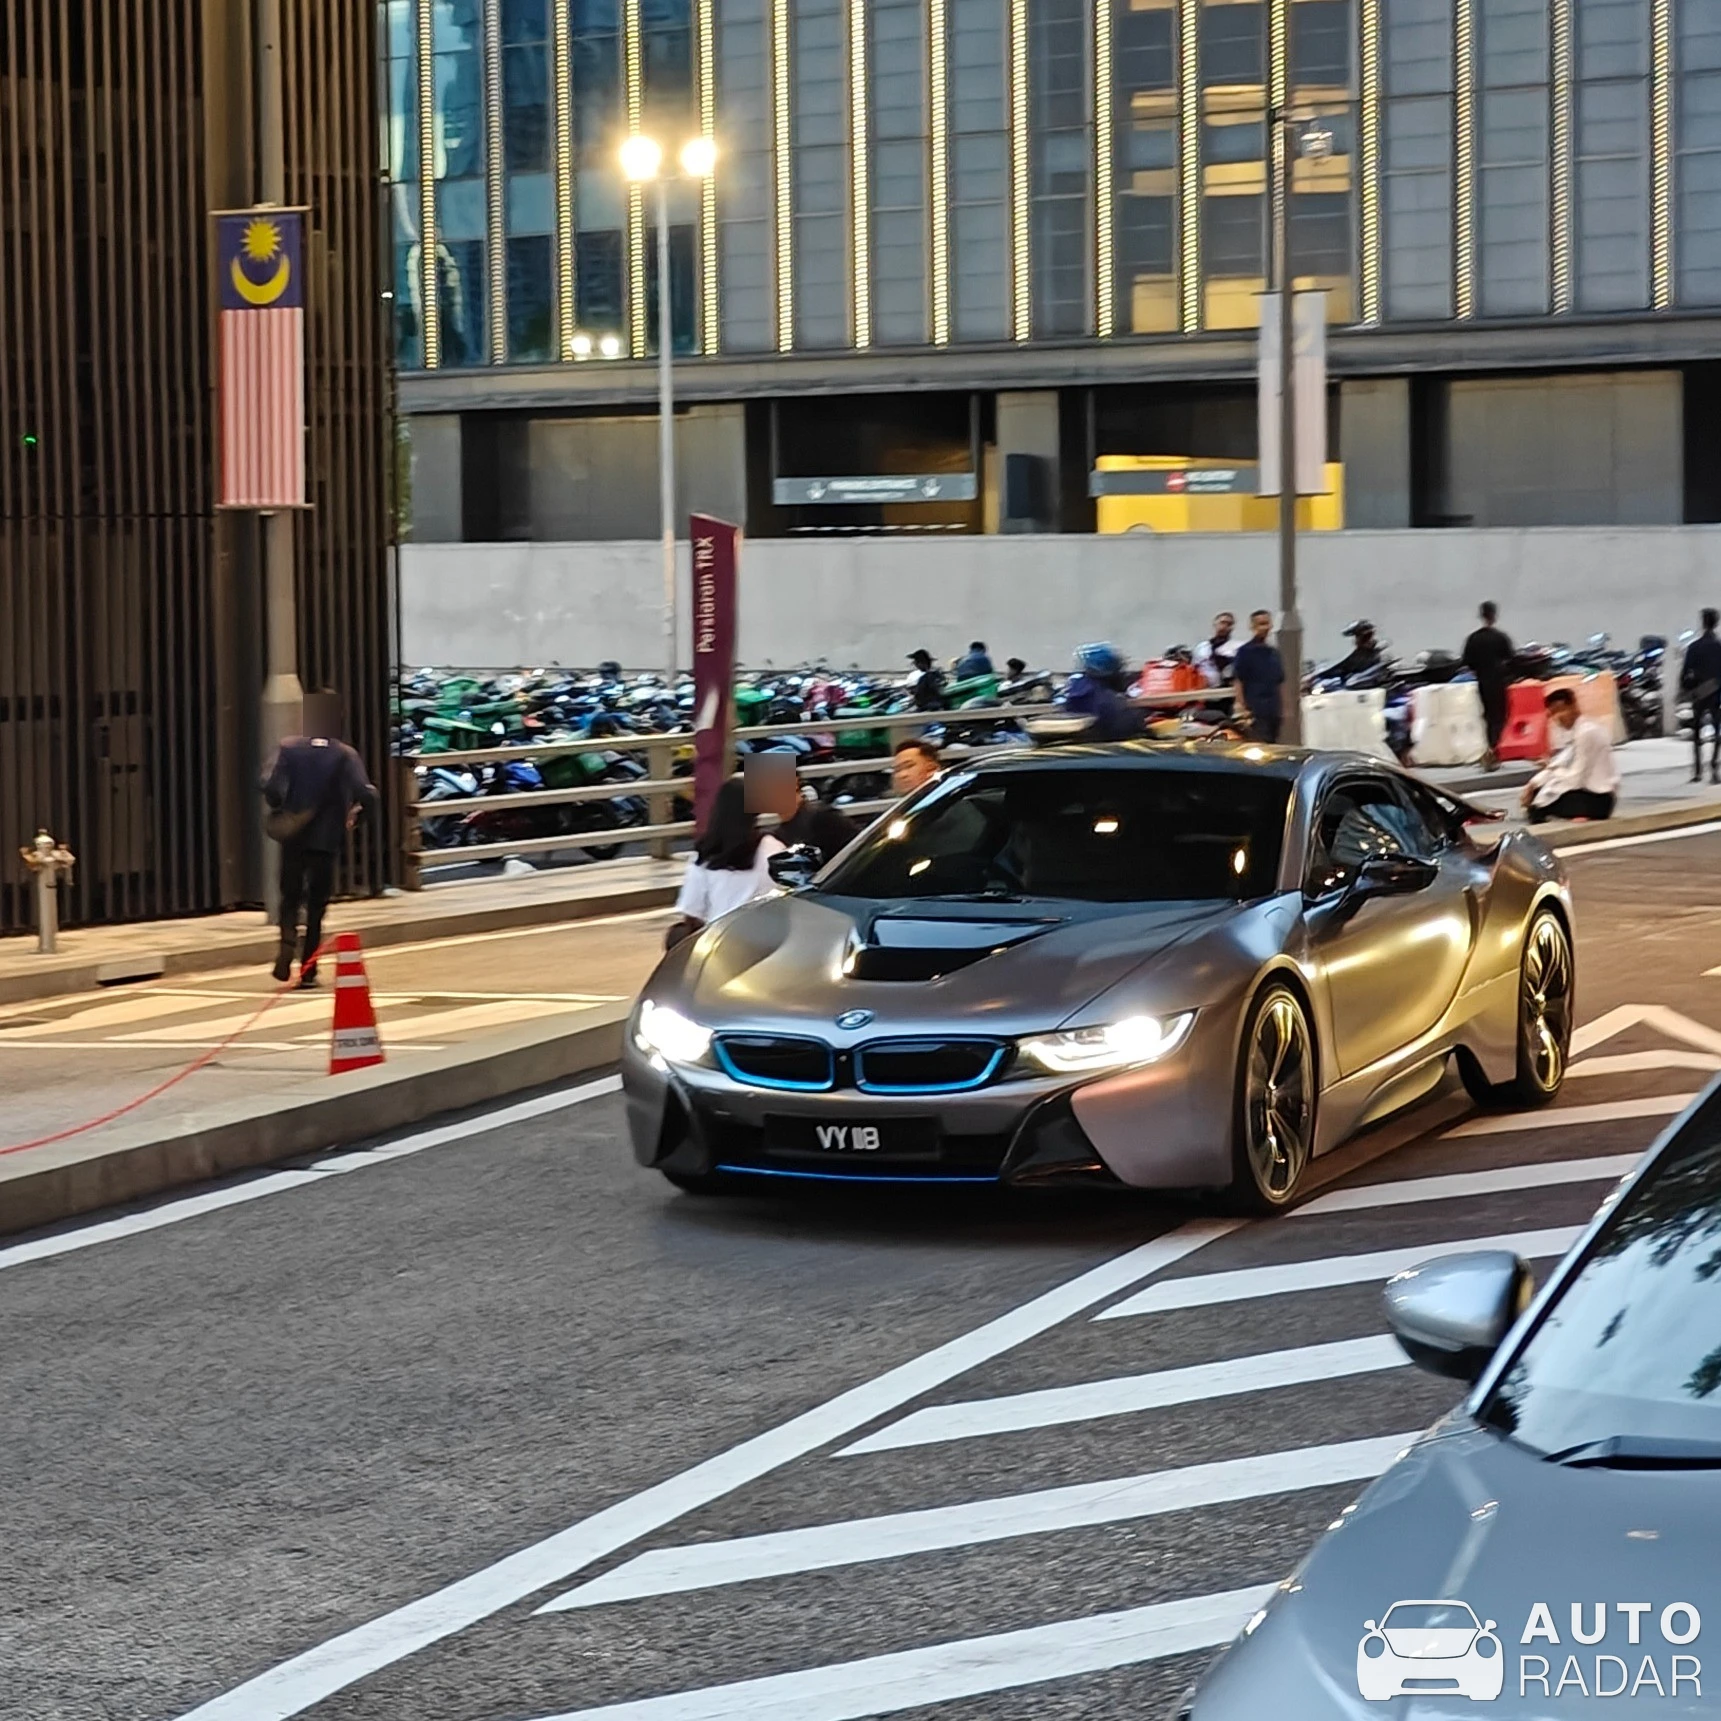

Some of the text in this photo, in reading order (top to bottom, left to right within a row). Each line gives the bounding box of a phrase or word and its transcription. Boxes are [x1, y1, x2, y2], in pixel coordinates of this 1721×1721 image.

[694, 536, 716, 653] Persiaran TRX
[815, 1125, 848, 1150] VY
